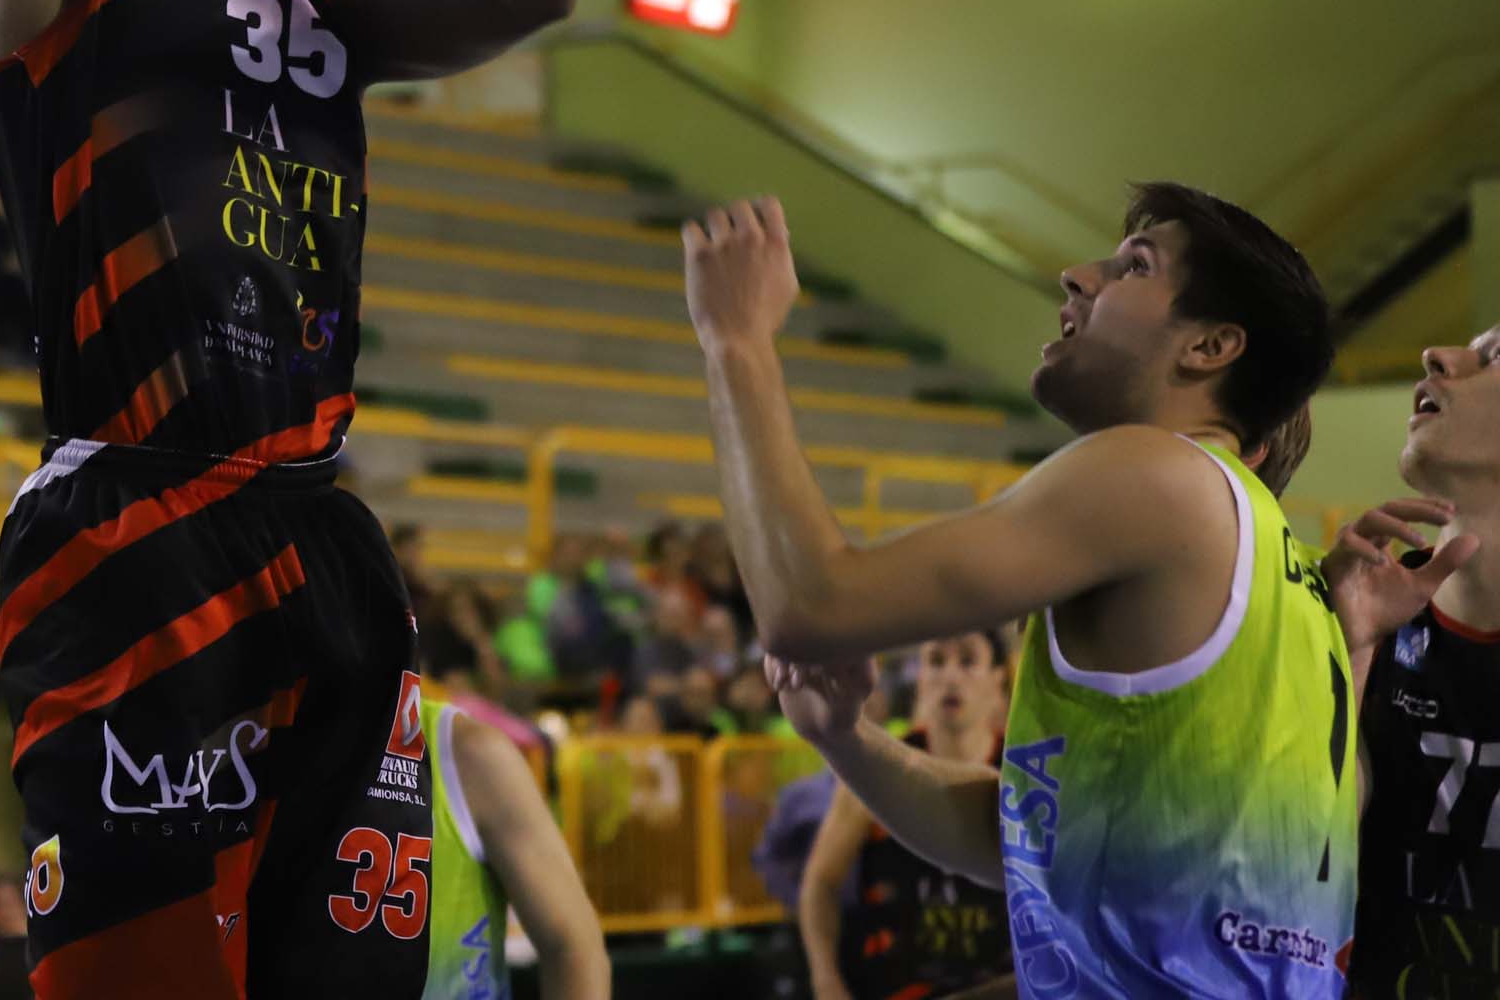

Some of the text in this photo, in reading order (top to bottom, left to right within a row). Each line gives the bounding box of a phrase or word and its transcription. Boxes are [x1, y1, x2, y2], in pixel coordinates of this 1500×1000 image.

[220, 89, 291, 152] LA
[222, 198, 324, 272] GUA
[101, 720, 268, 814] MAYS
[328, 826, 432, 940] 35
